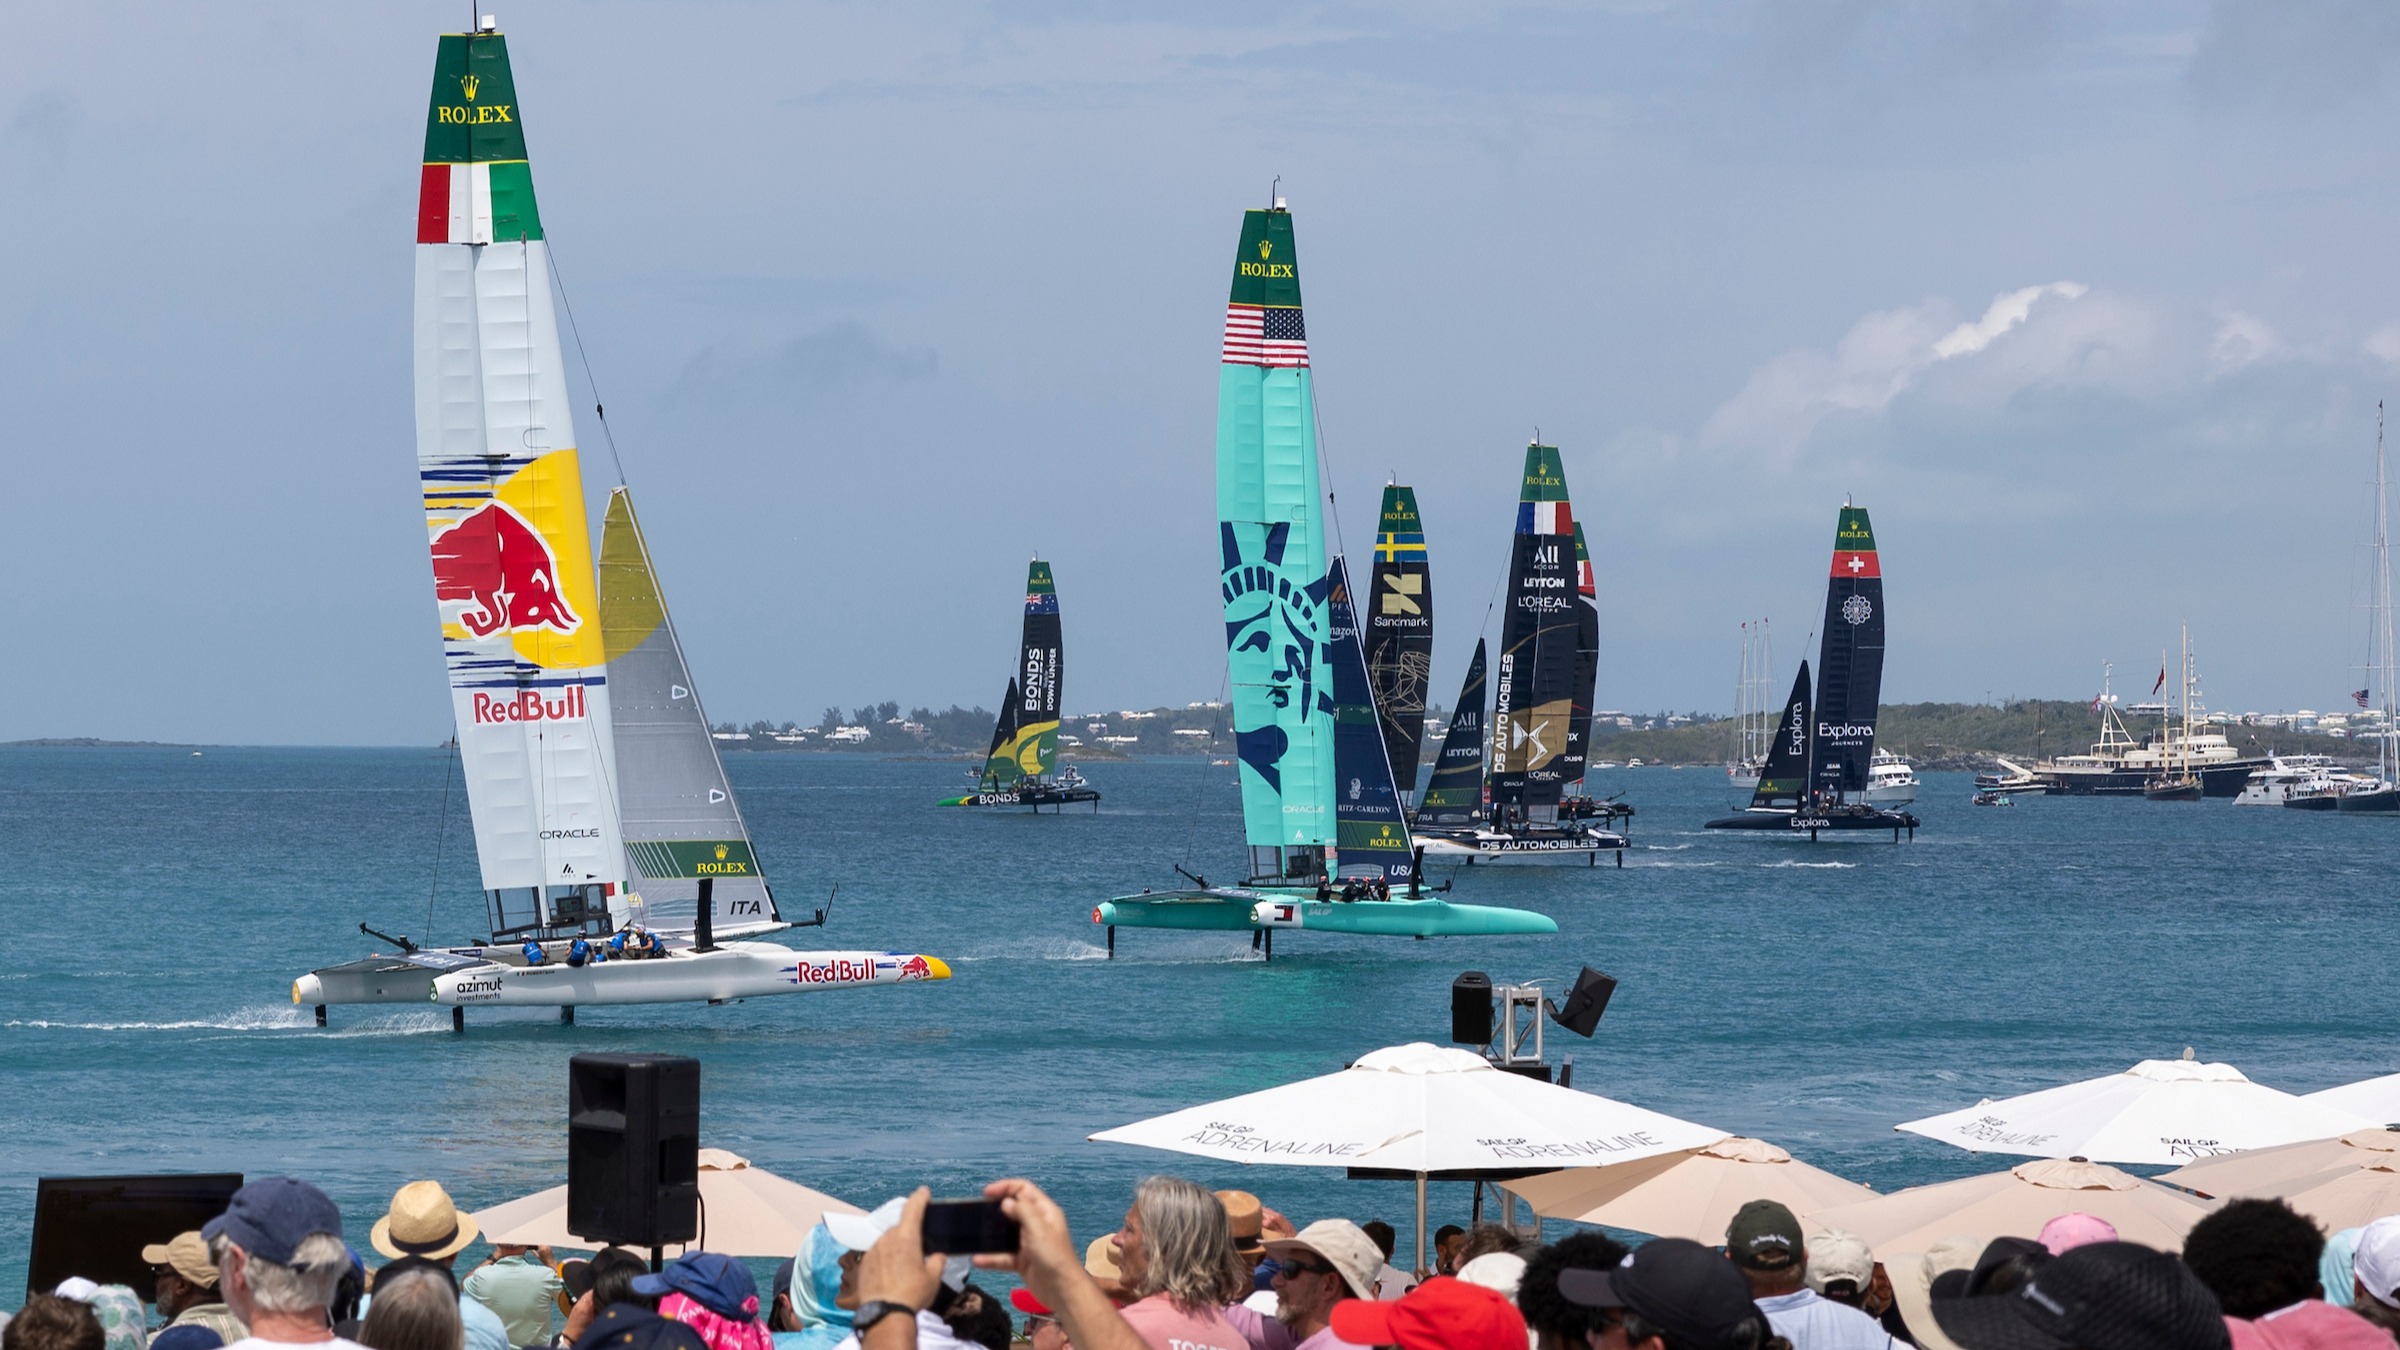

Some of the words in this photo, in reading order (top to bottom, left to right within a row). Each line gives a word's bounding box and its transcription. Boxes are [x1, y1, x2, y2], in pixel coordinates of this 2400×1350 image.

[438, 105, 512, 124] ROLEX
[1241, 262, 1293, 278] ROLEX
[1526, 476, 1560, 486] ROLEX
[1384, 512, 1416, 520] ROLEX
[1840, 530, 1870, 538] ROLEX
[1523, 577, 1565, 588] LEYTON
[1518, 595, 1573, 609] L'ORÉAL
[1374, 616, 1429, 628] Sandmark
[1049, 648, 1057, 679] UNDER
[1025, 648, 1041, 711] BONDS
[1047, 681, 1056, 711] DOWN
[1496, 654, 1514, 751] AUTOMOBILES
[1789, 702, 1806, 755] Explora
[1819, 722, 1874, 740] Explora
[1446, 748, 1480, 757] LEYTON
[1494, 753, 1506, 773] DS
[979, 793, 1020, 805] BONDS
[1282, 805, 1325, 814] ORACLE
[1791, 817, 1830, 828] Explora
[539, 827, 600, 840] ORACLE
[1370, 839, 1402, 848] ROLEX
[1480, 841, 1500, 851] DS
[1502, 839, 1599, 850] AUTOMOBILES
[696, 862, 747, 874] ROLEX
[730, 900, 762, 916] ITA
[457, 976, 503, 993] azimut
[457, 992, 501, 1002] investments
[1952, 1121, 2058, 1146] ADRENALINE
[1182, 1130, 1364, 1155] ADRENALINE
[1492, 1131, 1664, 1159] ADRENALINE
